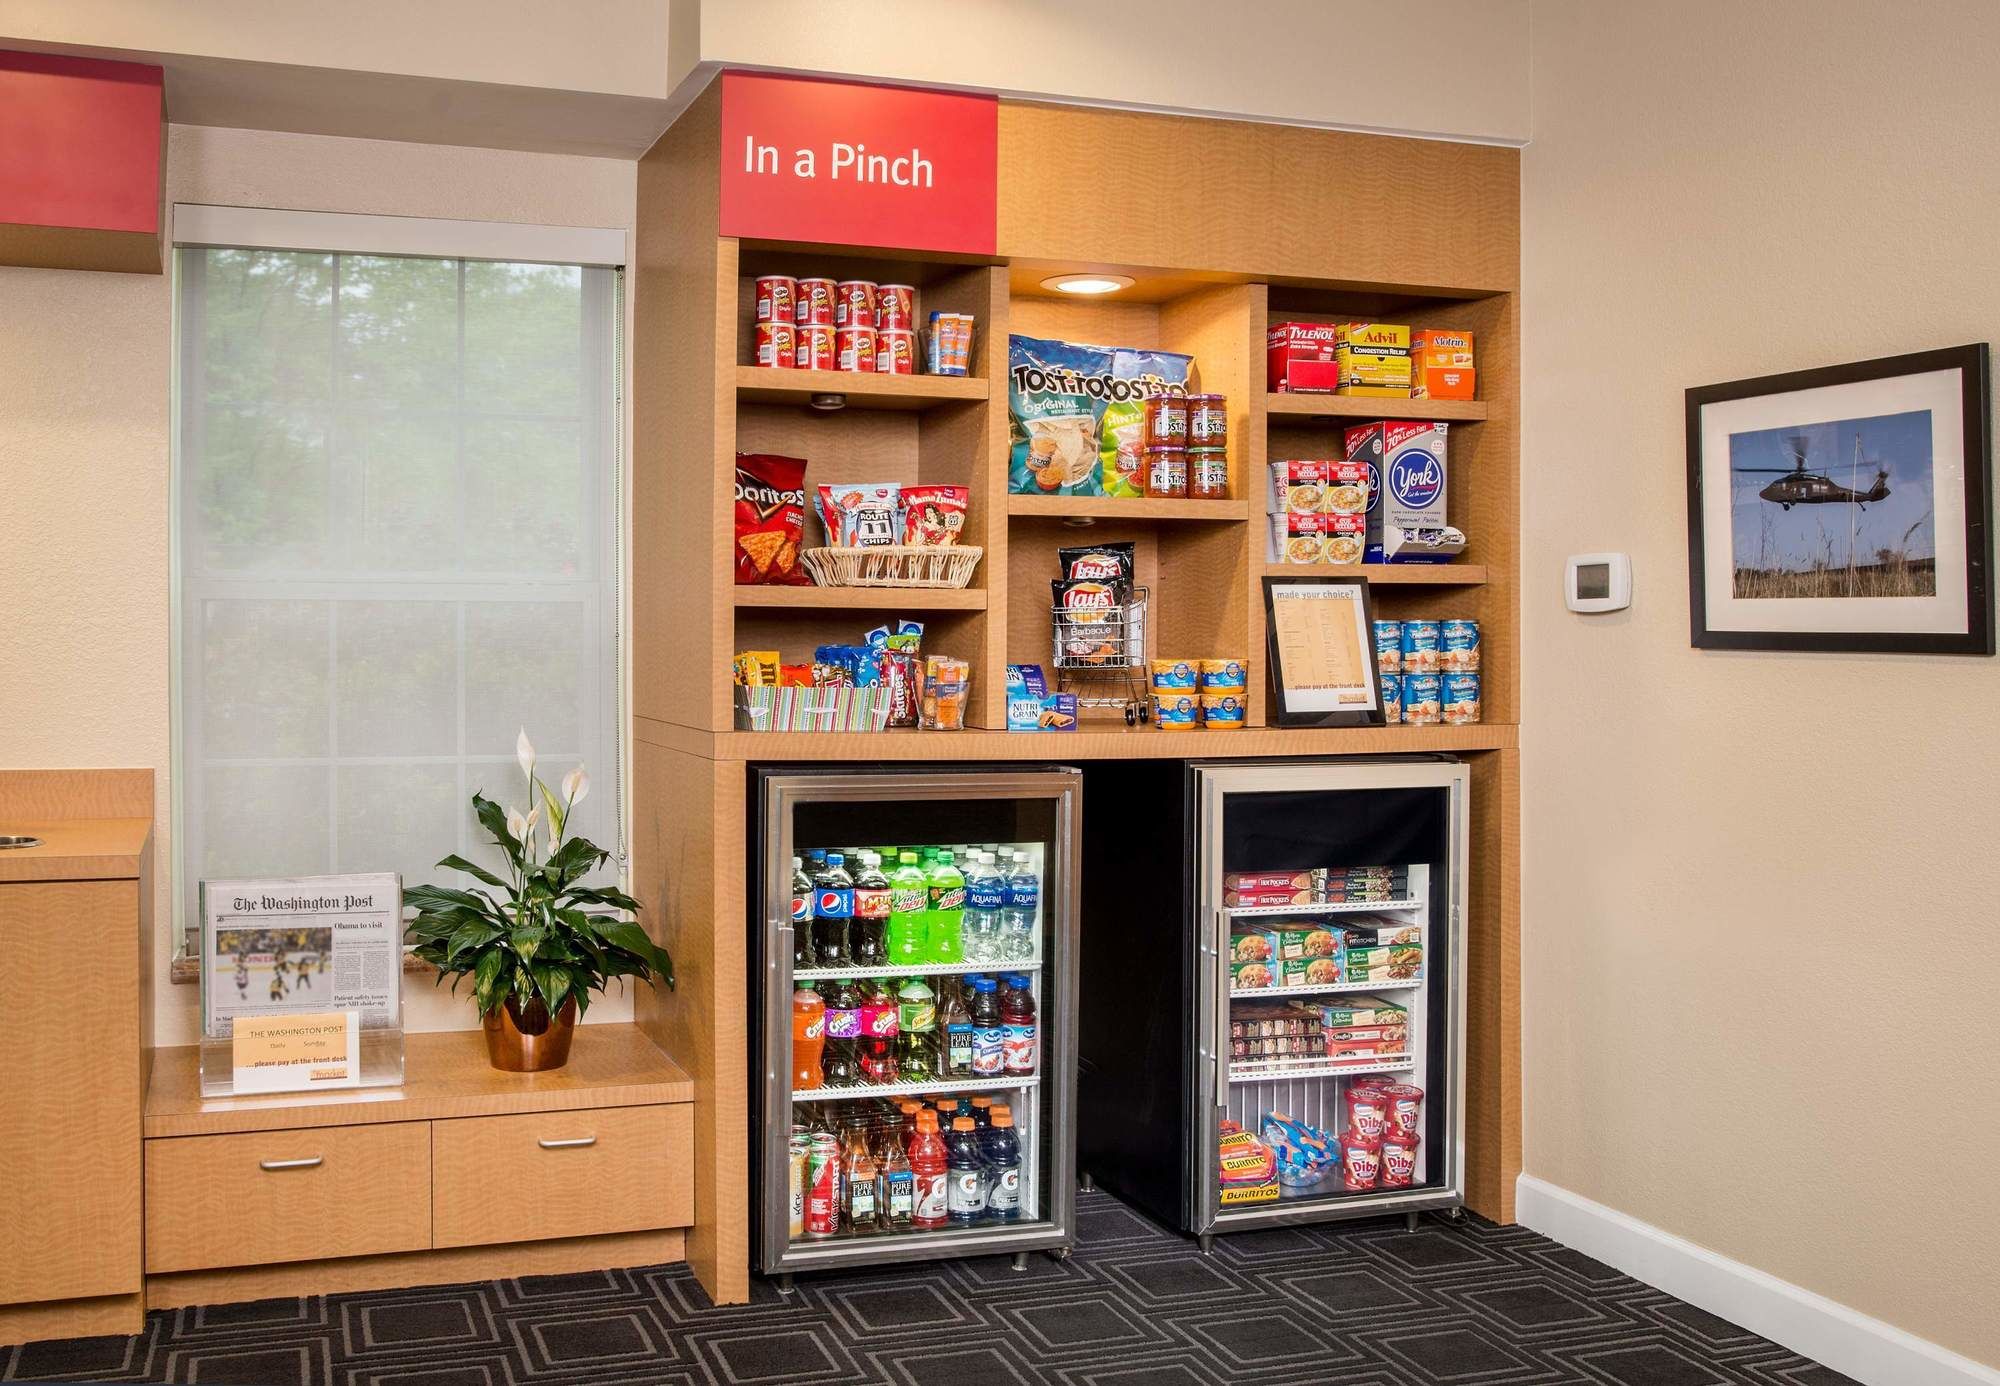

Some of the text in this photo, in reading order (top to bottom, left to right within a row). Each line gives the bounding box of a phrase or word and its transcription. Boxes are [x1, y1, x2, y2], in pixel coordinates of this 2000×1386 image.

[746, 136, 934, 187] In a Pinch
[1290, 326, 1334, 341] TYLENOL
[1364, 332, 1397, 344] Advil
[1354, 346, 1407, 356] CONGESTION RELIEF
[1014, 365, 1114, 401] TOSTITOS
[1397, 460, 1441, 498] York
[735, 483, 804, 506] Doritos
[860, 513, 889, 521] ROUTE
[864, 521, 888, 534] 11
[1068, 589, 1111, 609] Lay's
[1277, 590, 1354, 601] made your choice?
[1013, 703, 1038, 711] NUTRI
[1012, 710, 1038, 718] GRAIN
[234, 895, 374, 912] The Washington Post
[971, 894, 1002, 904] AQUAFINA
[828, 1012, 855, 1034] Crush
[873, 1010, 897, 1033] Crush
[251, 1025, 344, 1038] THE WASHINGTON POST
[951, 1034, 971, 1042] PURE
[1358, 1117, 1384, 1129] Dibs
[1401, 1112, 1418, 1125] Dib
[1352, 1160, 1378, 1173] Dibs
[1388, 1156, 1413, 1169] Dibs
[853, 1182, 873, 1190] PURE
[891, 1181, 912, 1190] PURE
[853, 1188, 873, 1197] LEAF
[891, 1188, 911, 1196] LEAF
[1227, 1188, 1279, 1200] BURRITOS
